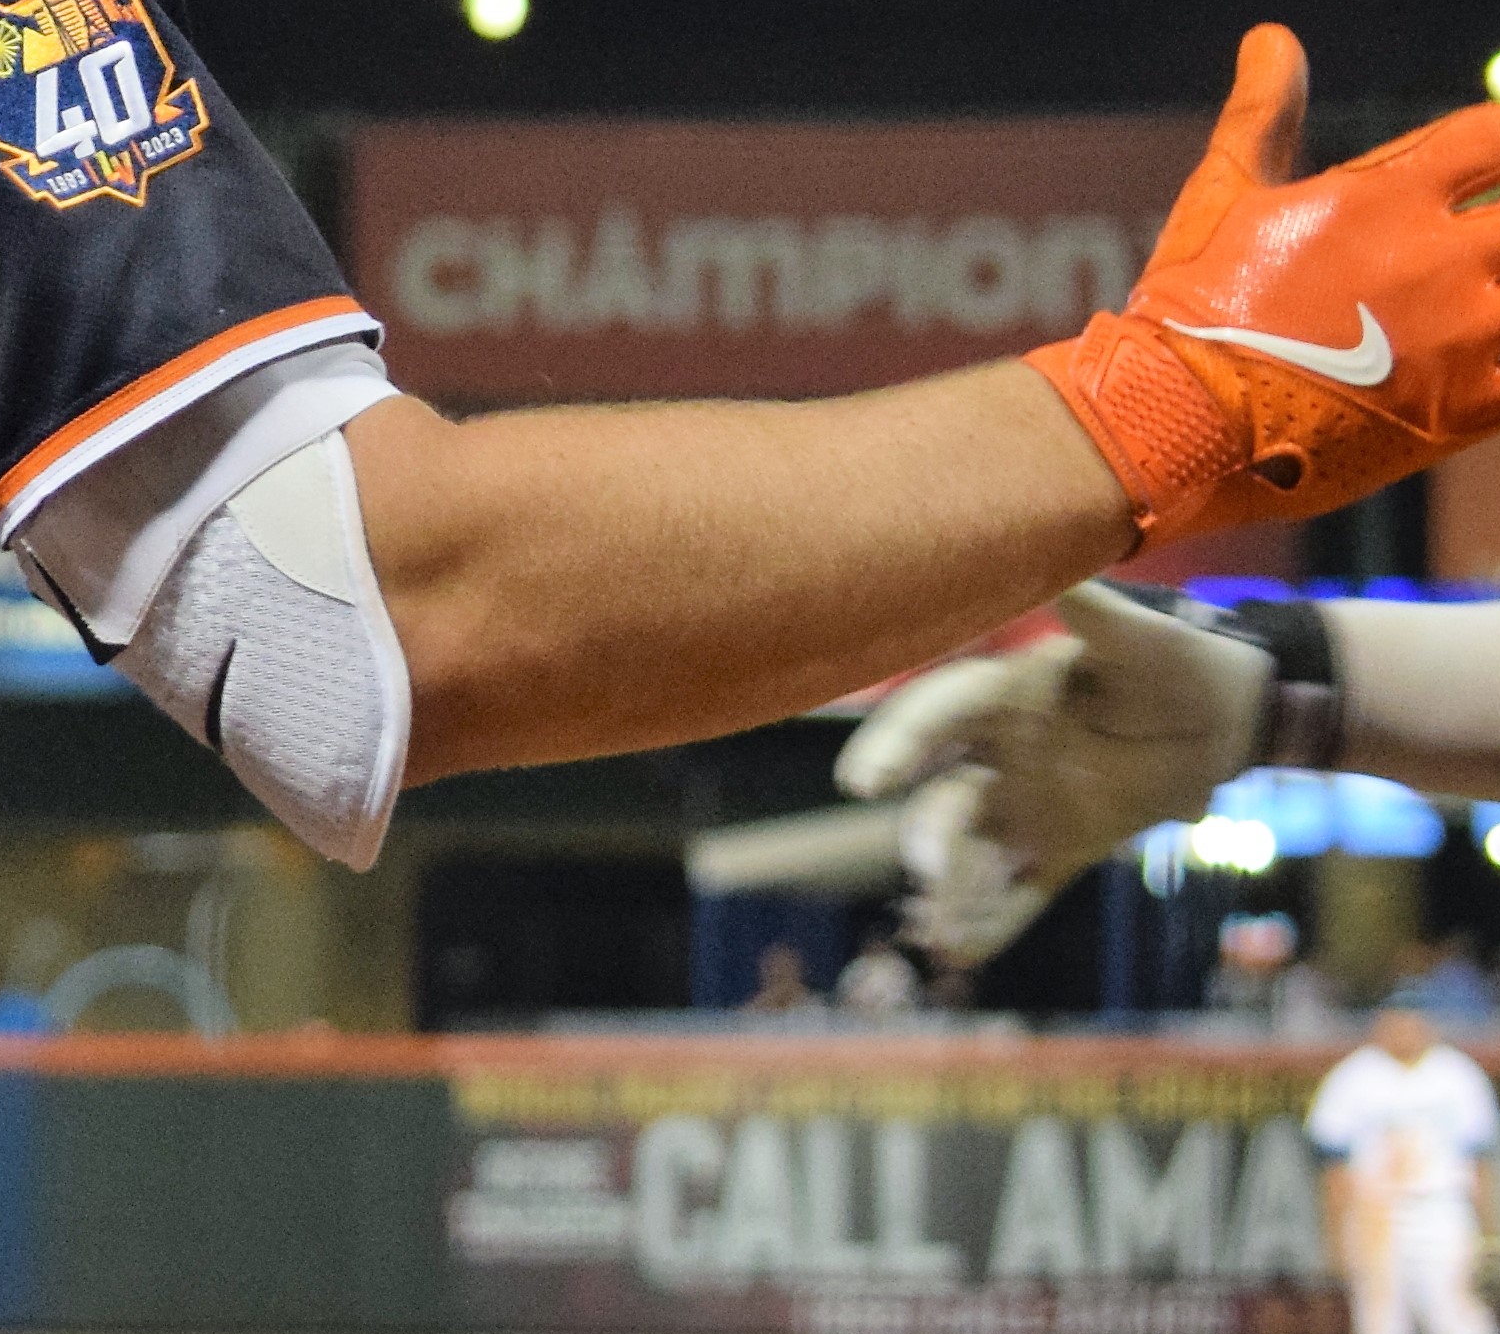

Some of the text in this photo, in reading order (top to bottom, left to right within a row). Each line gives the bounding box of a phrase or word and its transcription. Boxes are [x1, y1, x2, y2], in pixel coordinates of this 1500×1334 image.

[34, 39, 152, 160] 40
[139, 125, 187, 160] 2023
[390, 199, 1165, 335] CHAMPION
[632, 1112, 962, 1291] CALL
